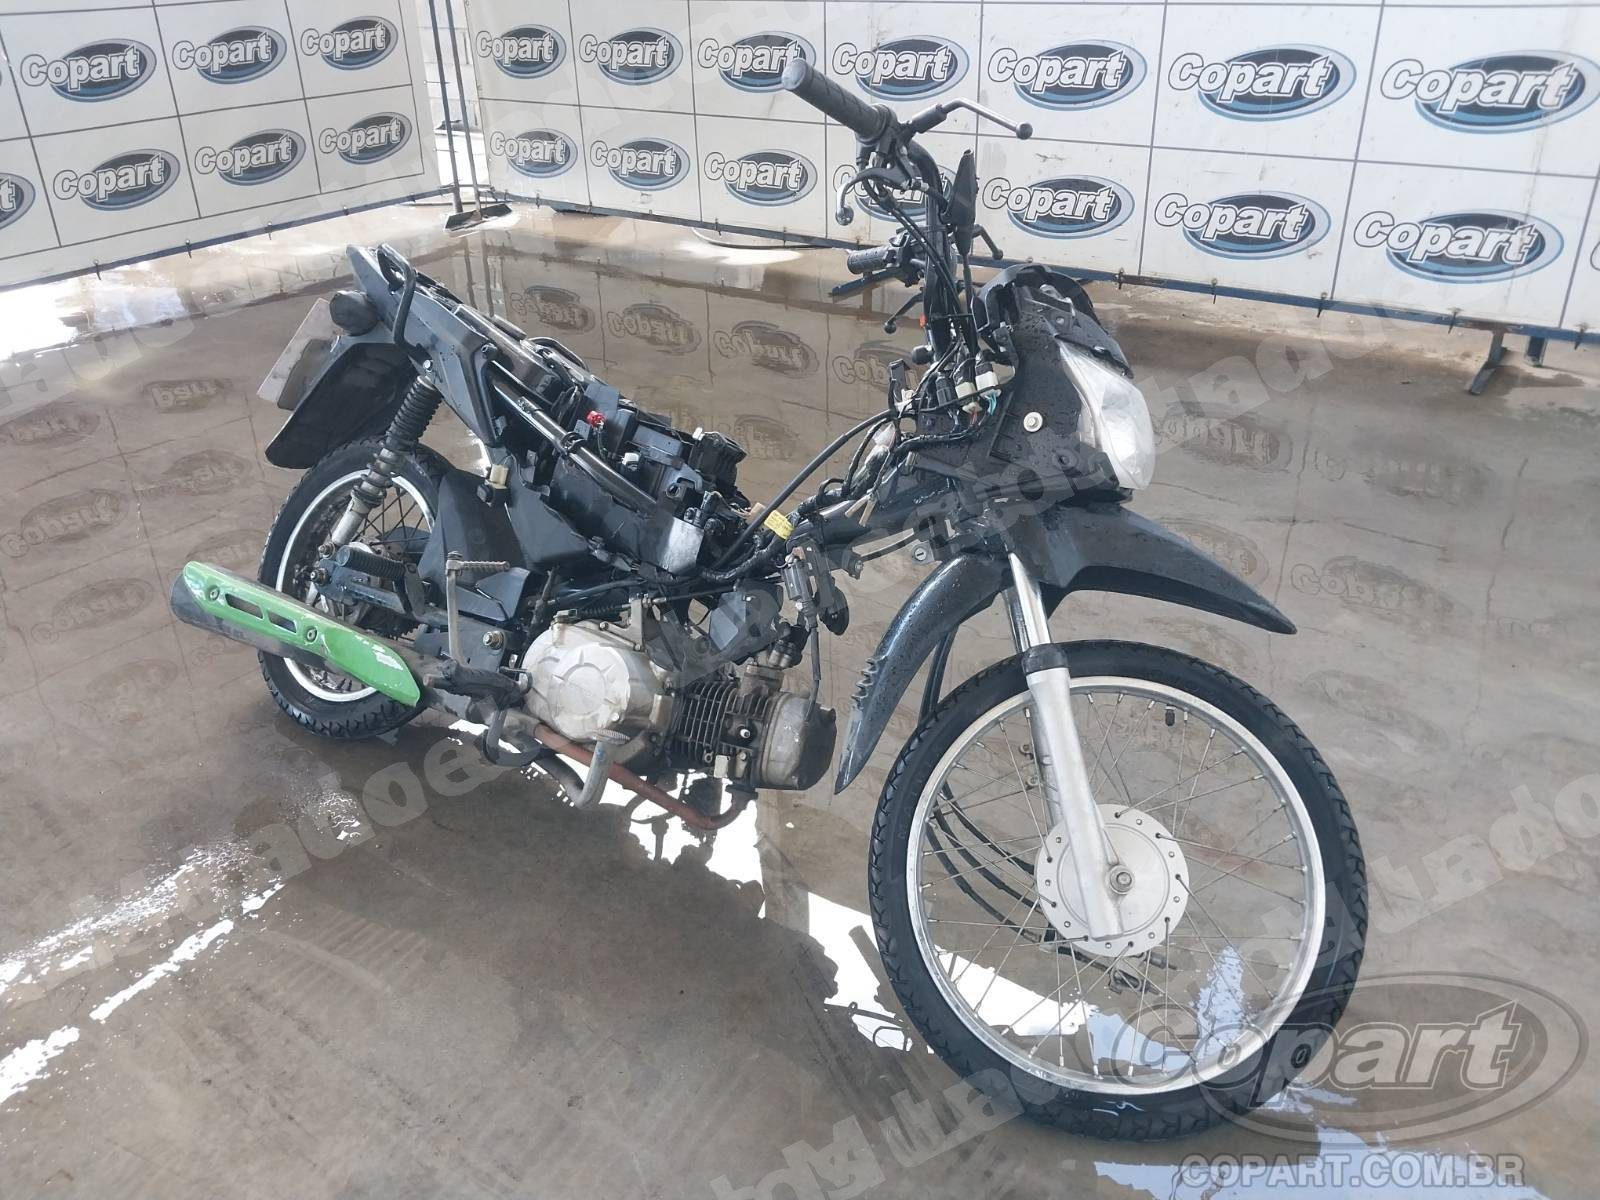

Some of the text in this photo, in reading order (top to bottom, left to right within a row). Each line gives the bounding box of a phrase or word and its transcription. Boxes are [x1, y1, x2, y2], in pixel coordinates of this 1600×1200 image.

[172, 31, 272, 74] Copart
[301, 21, 387, 60] Copart
[476, 30, 554, 63] Copart
[579, 33, 670, 69] Copart
[20, 42, 140, 91] Copart
[832, 42, 950, 85] Copart
[988, 47, 1127, 93] Copart
[1168, 53, 1331, 103] Copart
[1380, 59, 1576, 113] Copart
[194, 135, 292, 180] Copart
[318, 116, 401, 156] Copart
[490, 131, 566, 165] Copart
[53, 154, 164, 201] Copart
[590, 141, 678, 177] Copart
[704, 151, 805, 191] Copart
[982, 178, 1116, 221] Copart
[1155, 192, 1309, 240] Copart
[1354, 211, 1536, 264] Copart
